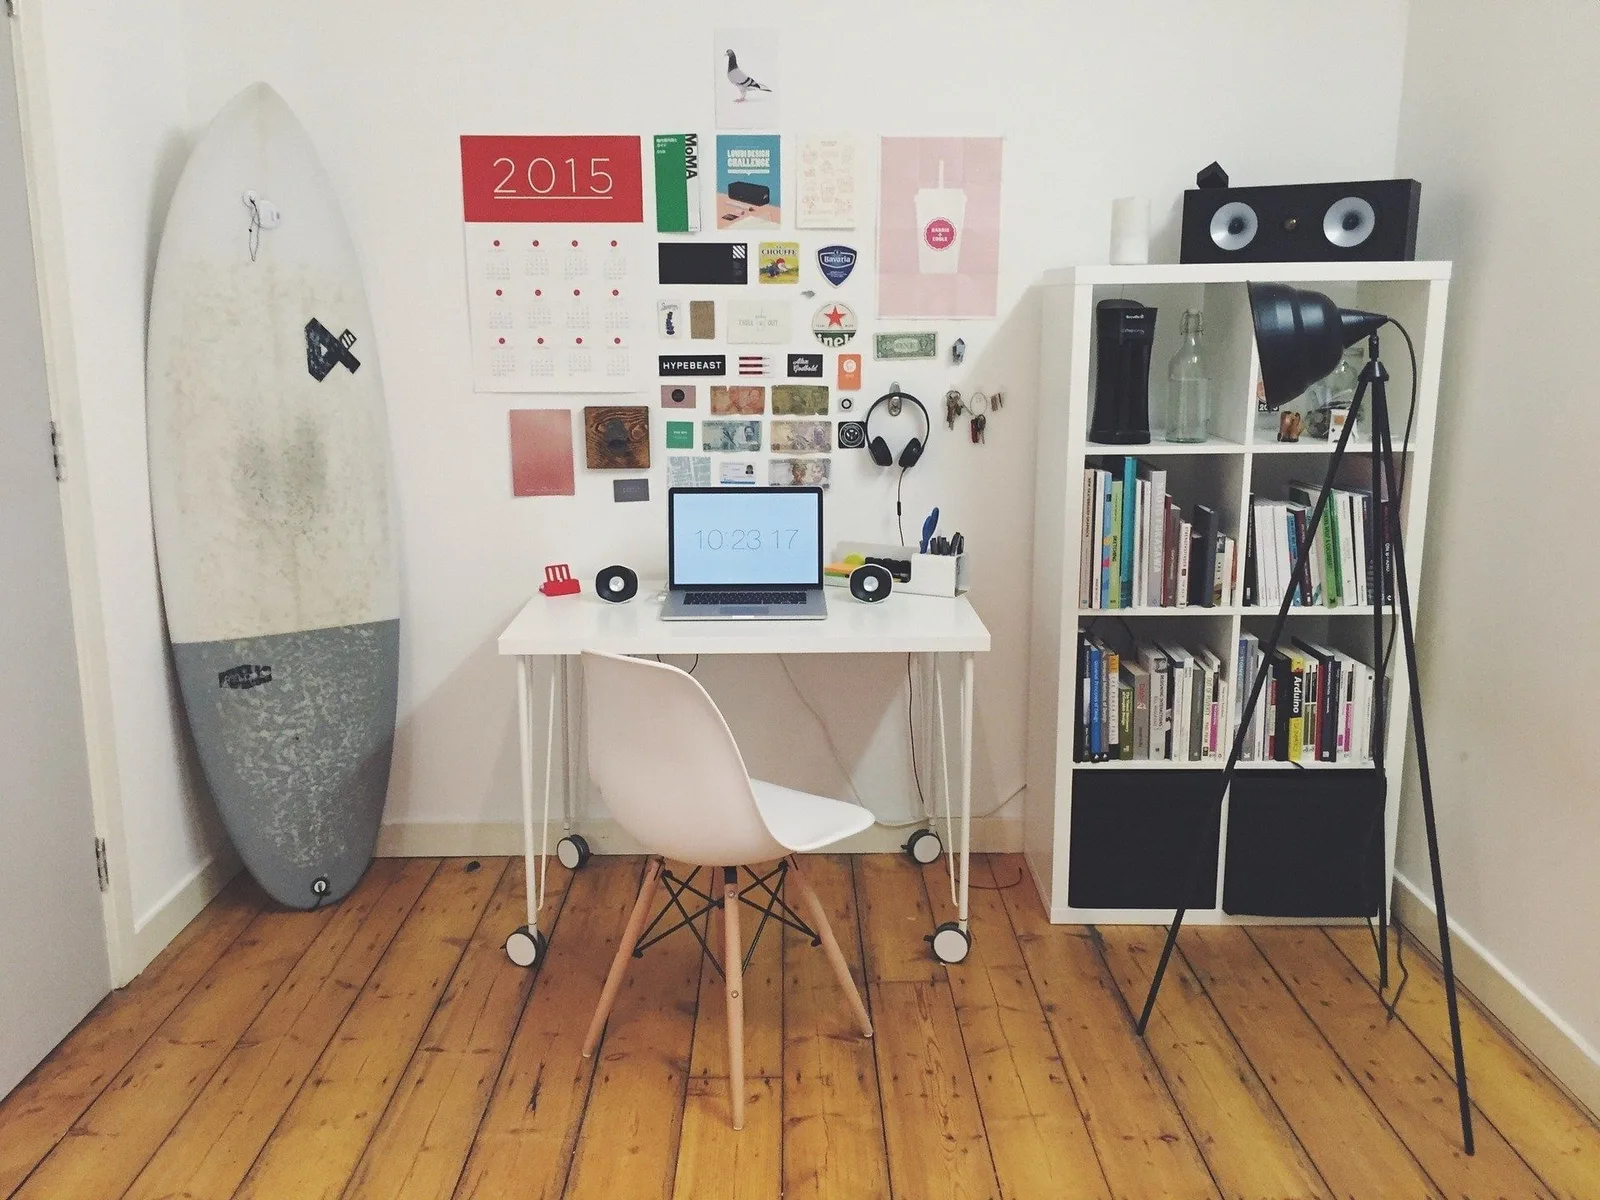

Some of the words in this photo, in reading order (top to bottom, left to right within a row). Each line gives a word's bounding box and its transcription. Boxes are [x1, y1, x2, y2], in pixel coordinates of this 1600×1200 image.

[685, 133, 698, 180] MoMA
[727, 158, 770, 168] CHALLENGE
[493, 157, 613, 194] 2015
[824, 255, 851, 263] Bavaria
[662, 361, 722, 370] HYPEBEAST
[772, 529, 799, 550] 17
[1153, 517, 1162, 573] FUKASAWA
[1292, 676, 1302, 713] Arduino
